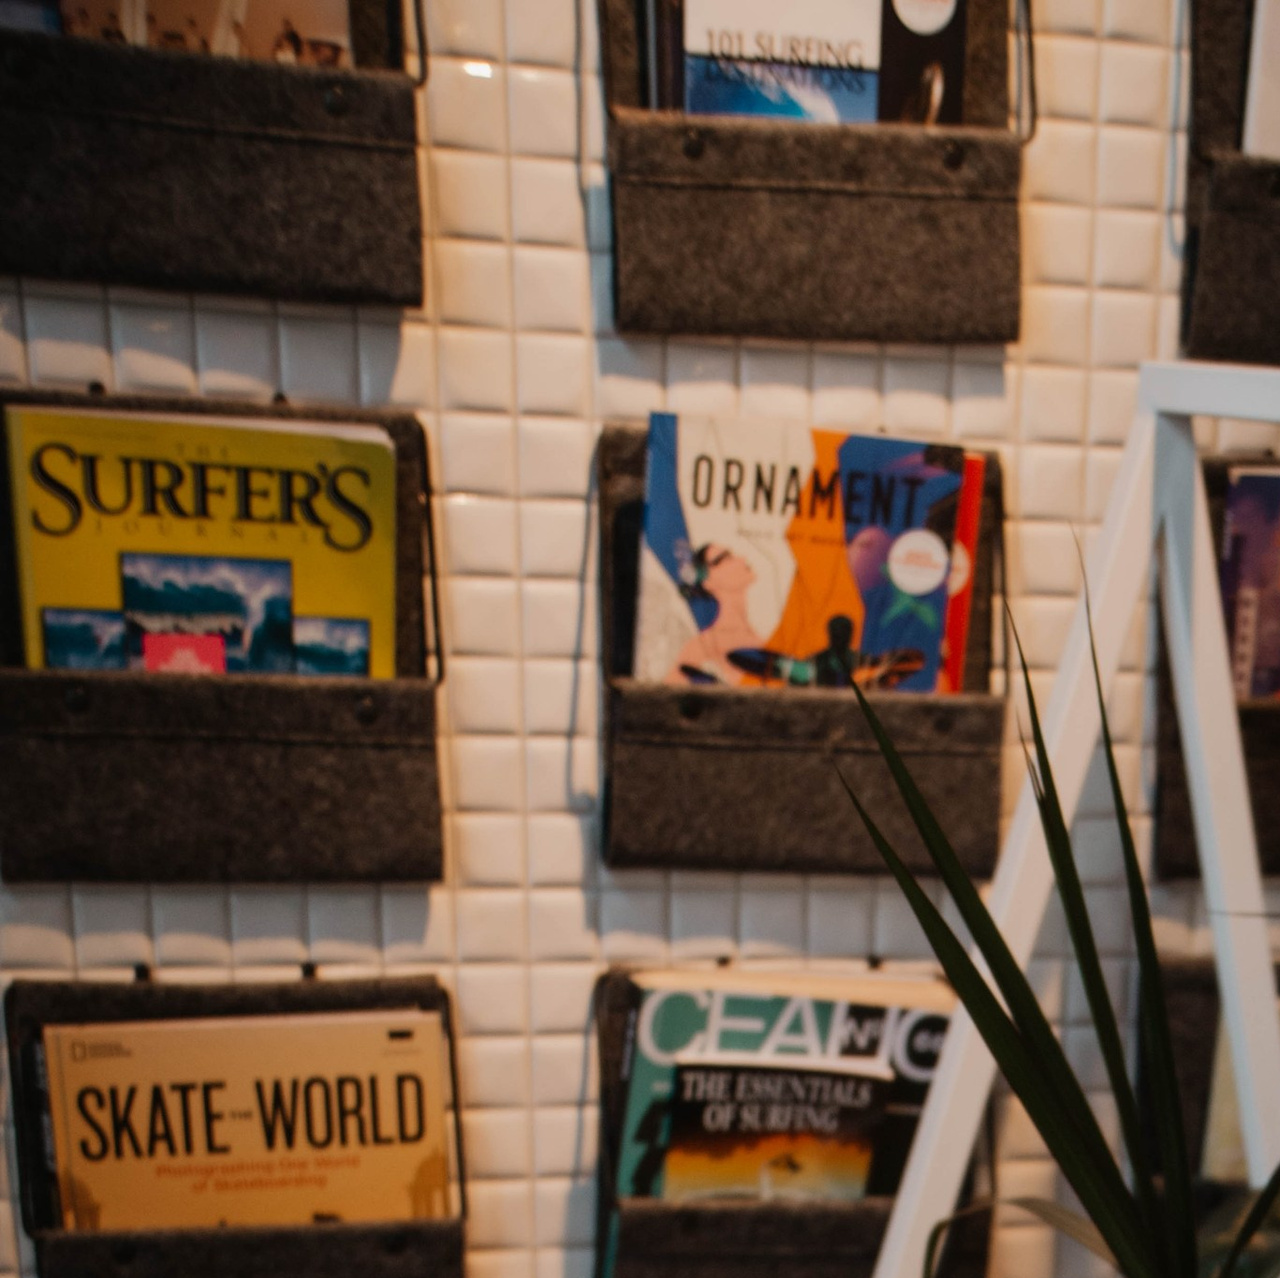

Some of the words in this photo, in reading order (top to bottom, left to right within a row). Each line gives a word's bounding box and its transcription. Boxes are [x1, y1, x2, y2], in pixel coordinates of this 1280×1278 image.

[755, 32, 864, 69] SURFING
[30, 442, 373, 551] SURFER'S
[691, 454, 926, 528] ORNAMENT
[682, 1071, 732, 1100] THE
[736, 1072, 872, 1108] ESSENTIALS
[76, 1080, 231, 1162] SKATE
[255, 1073, 426, 1152] WORLD
[702, 1103, 735, 1132] OF
